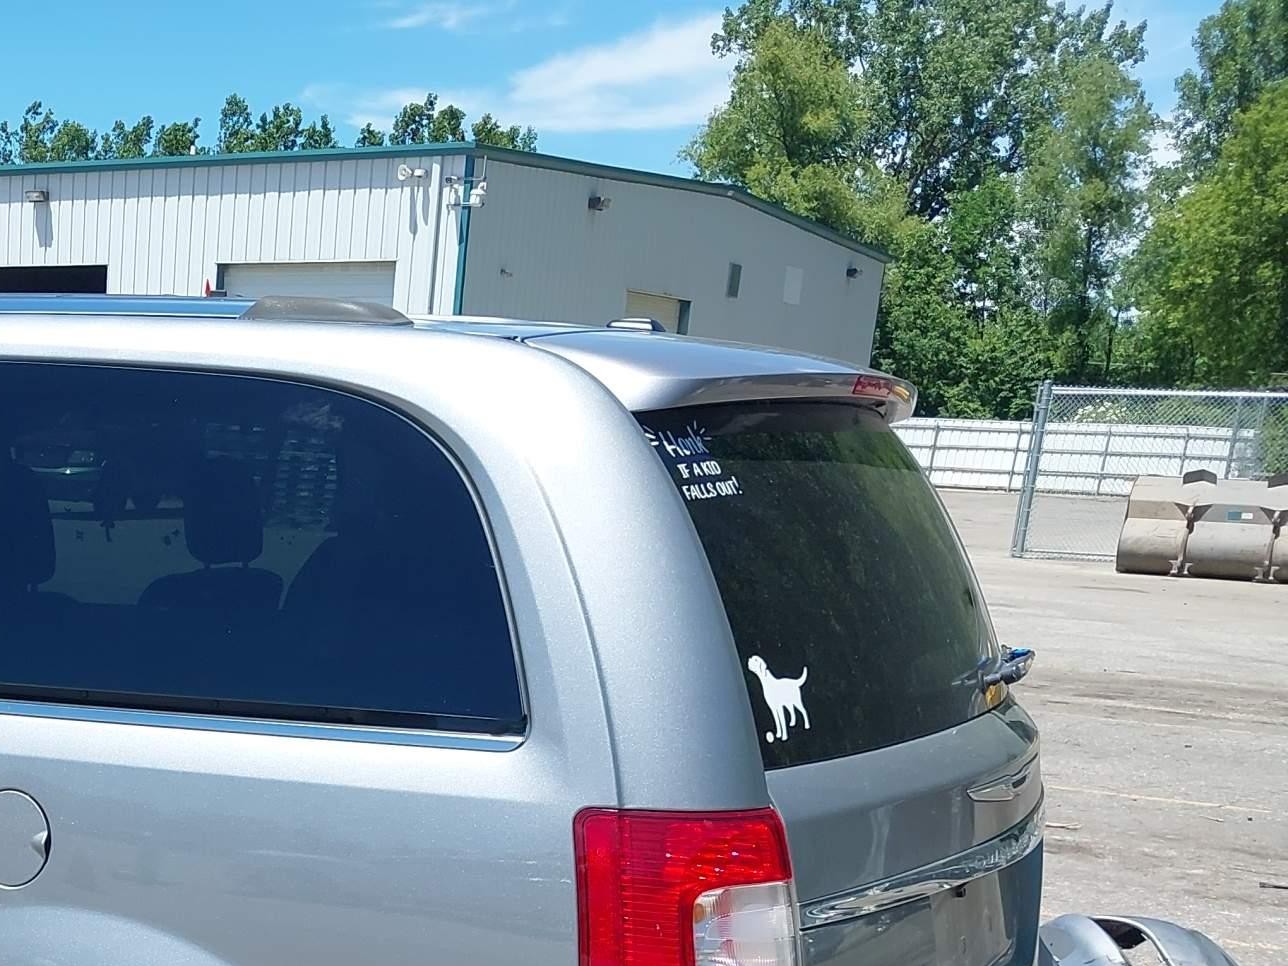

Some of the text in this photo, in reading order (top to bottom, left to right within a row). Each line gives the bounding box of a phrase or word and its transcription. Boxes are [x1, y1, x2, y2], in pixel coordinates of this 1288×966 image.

[658, 425, 709, 457] Honk
[677, 460, 721, 478] IF A KID
[682, 476, 743, 500] FALLS OUT!
